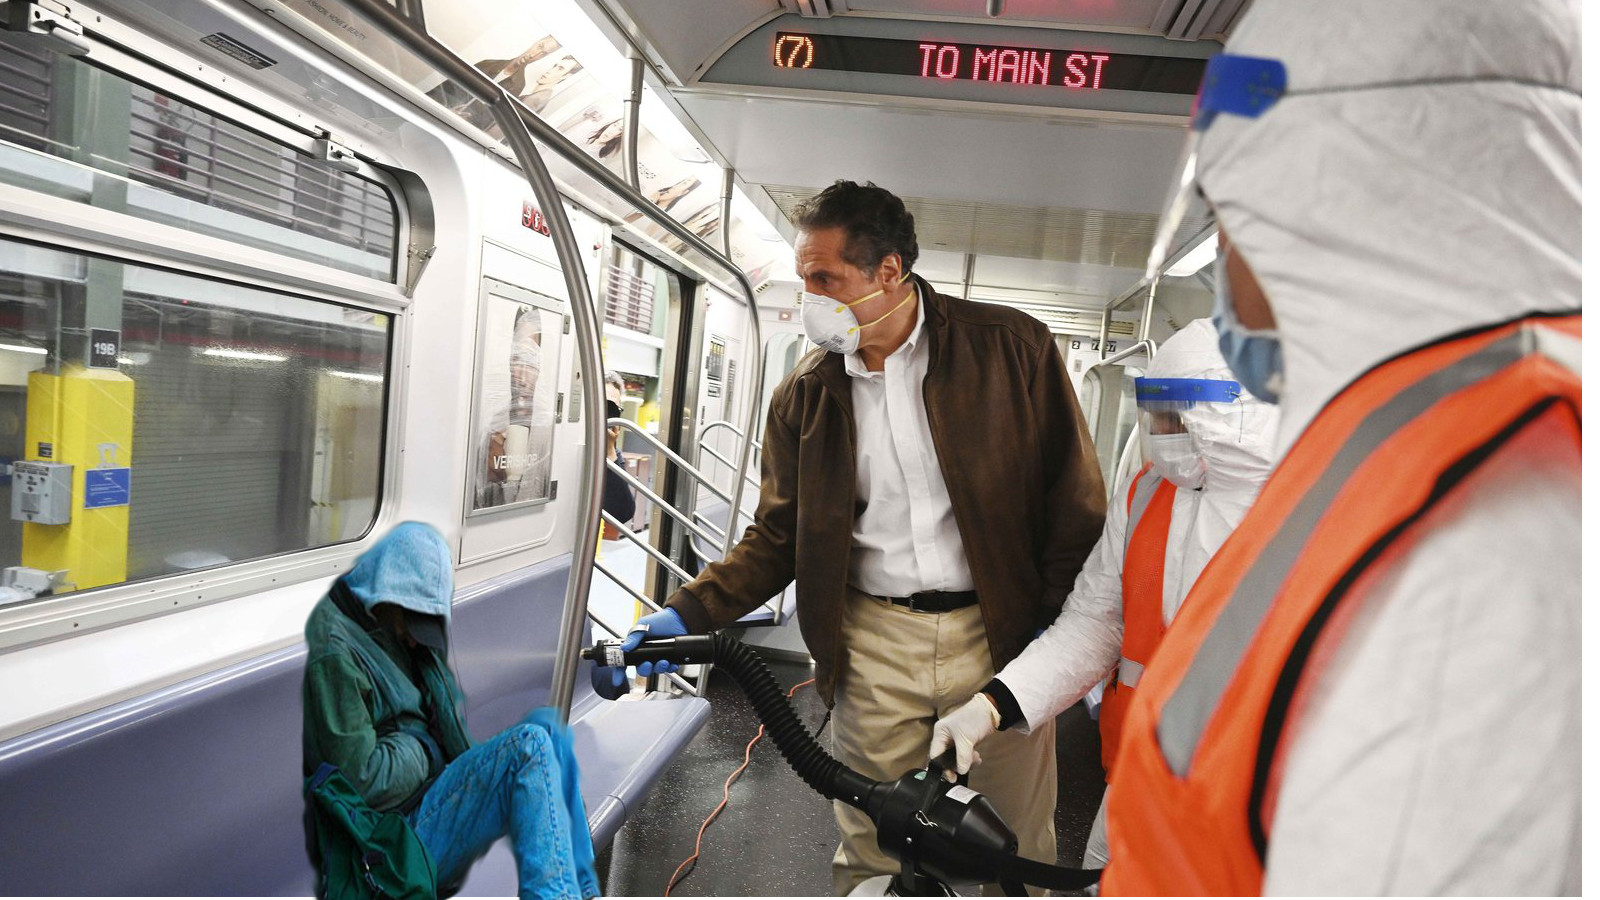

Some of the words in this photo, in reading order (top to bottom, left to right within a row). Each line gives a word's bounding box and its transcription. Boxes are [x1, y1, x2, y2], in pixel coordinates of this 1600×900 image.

[919, 44, 960, 79] TO
[973, 48, 1051, 85] MAIN
[1063, 54, 1109, 89] ST
[94, 342, 116, 356] 19B
